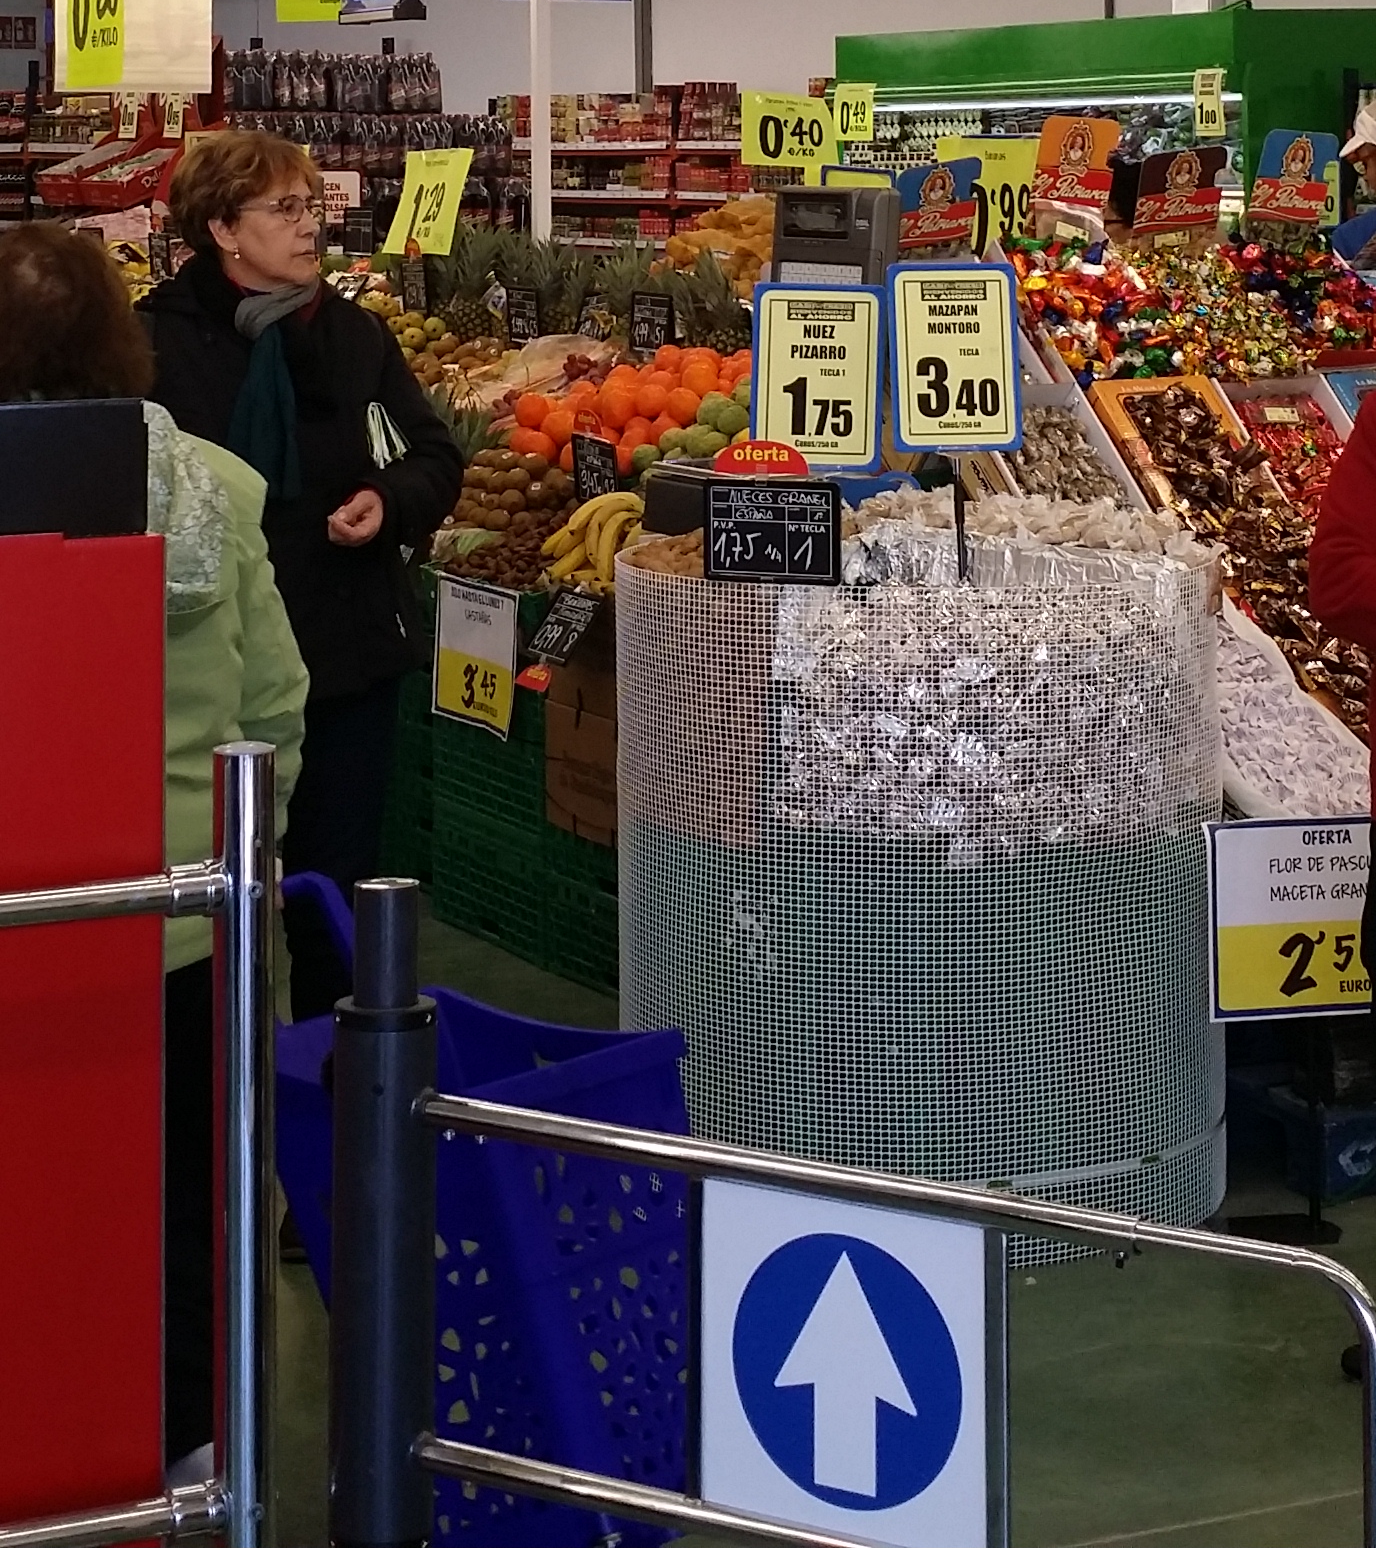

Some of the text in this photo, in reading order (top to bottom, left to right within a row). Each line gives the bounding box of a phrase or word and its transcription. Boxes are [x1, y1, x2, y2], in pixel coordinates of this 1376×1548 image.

[325, 193, 349, 201] ANTES
[928, 305, 977, 316] MAZAPAN
[803, 324, 835, 339] NUEZ
[928, 322, 980, 334] MONTORO
[791, 344, 846, 360] PIZARRO
[959, 348, 979, 356] TECLA
[820, 368, 845, 377] TECLA 1
[783, 377, 853, 437] 1,75
[733, 445, 789, 462] oferta
[730, 489, 827, 507] NUECES GRANEL
[736, 507, 773, 519] ESPAÑA
[714, 532, 812, 571] 1,75 1
[1303, 829, 1352, 845] OFERTA
[1270, 856, 1371, 873] FLOR DE PASCU
[1270, 883, 1367, 901] MACETA GRAN
[1279, 931, 1355, 997] 2'5
[1340, 980, 1371, 992] EURO
